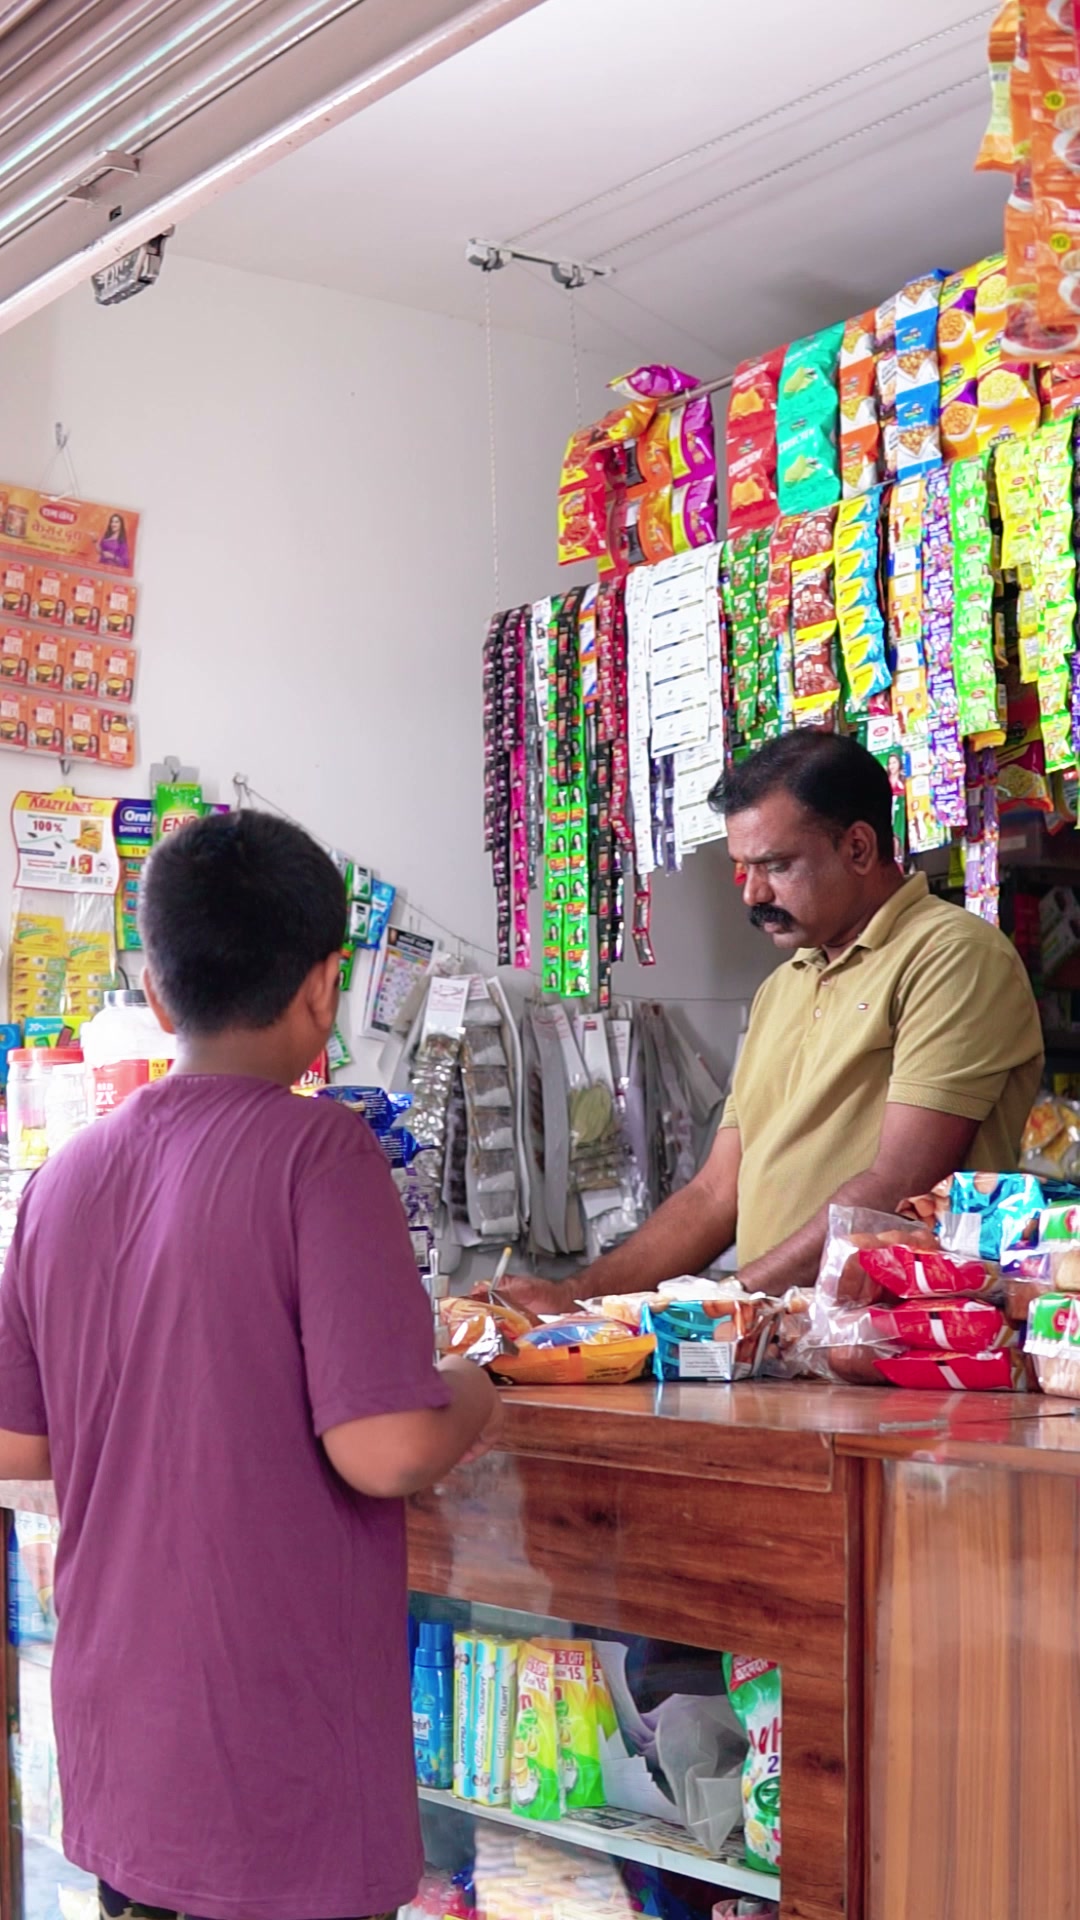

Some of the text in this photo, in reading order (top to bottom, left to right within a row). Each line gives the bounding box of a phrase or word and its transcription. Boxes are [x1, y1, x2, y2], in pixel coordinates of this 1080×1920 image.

[27, 796, 93, 813] KRAZY LINES
[123, 809, 151, 823] Oral
